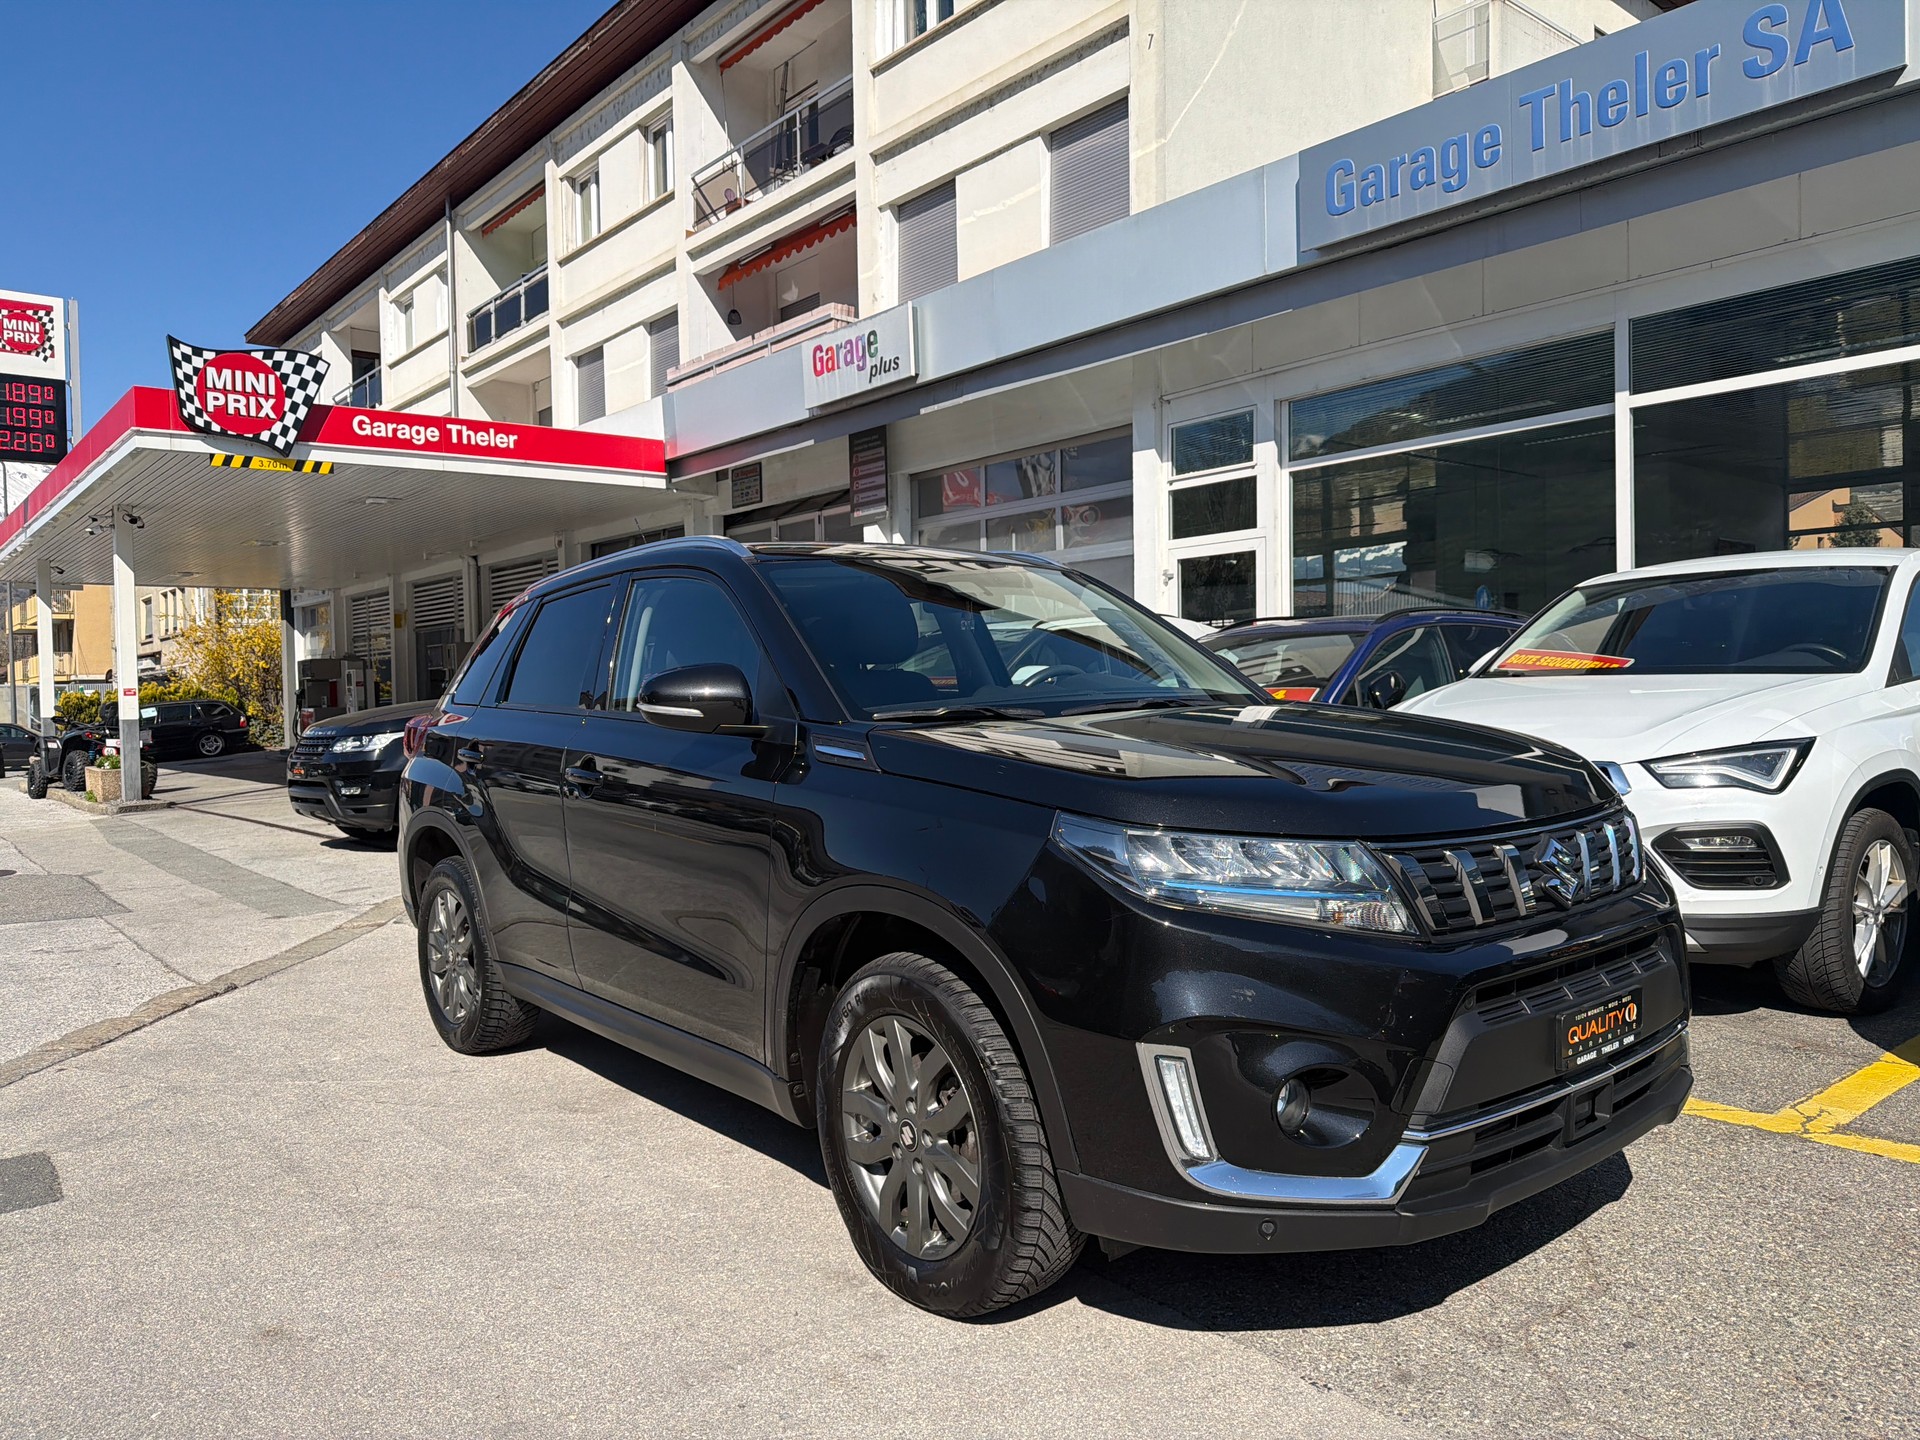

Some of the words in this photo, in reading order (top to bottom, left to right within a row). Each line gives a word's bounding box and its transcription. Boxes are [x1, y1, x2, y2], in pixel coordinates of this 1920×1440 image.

[1325, 122, 1502, 217] Garage
[1518, 41, 1722, 153] Theler
[1741, 0, 1855, 79] SA
[2, 318, 40, 333] MINI
[3, 331, 41, 345] PRIX
[812, 329, 879, 378] Garage
[206, 366, 276, 396] MINI
[868, 355, 900, 384] plus
[206, 391, 278, 419] PRIX
[352, 414, 440, 445] Garage
[446, 423, 519, 449] Theler
[258, 459, 278, 469] 3.70
[1506, 653, 1542, 665] BOITE
[1568, 1022, 1637, 1056] GARANTIE
[1576, 1050, 1598, 1065] GARAGE
[1601, 1041, 1620, 1055] THELER
[1623, 1034, 1635, 1045] SION
